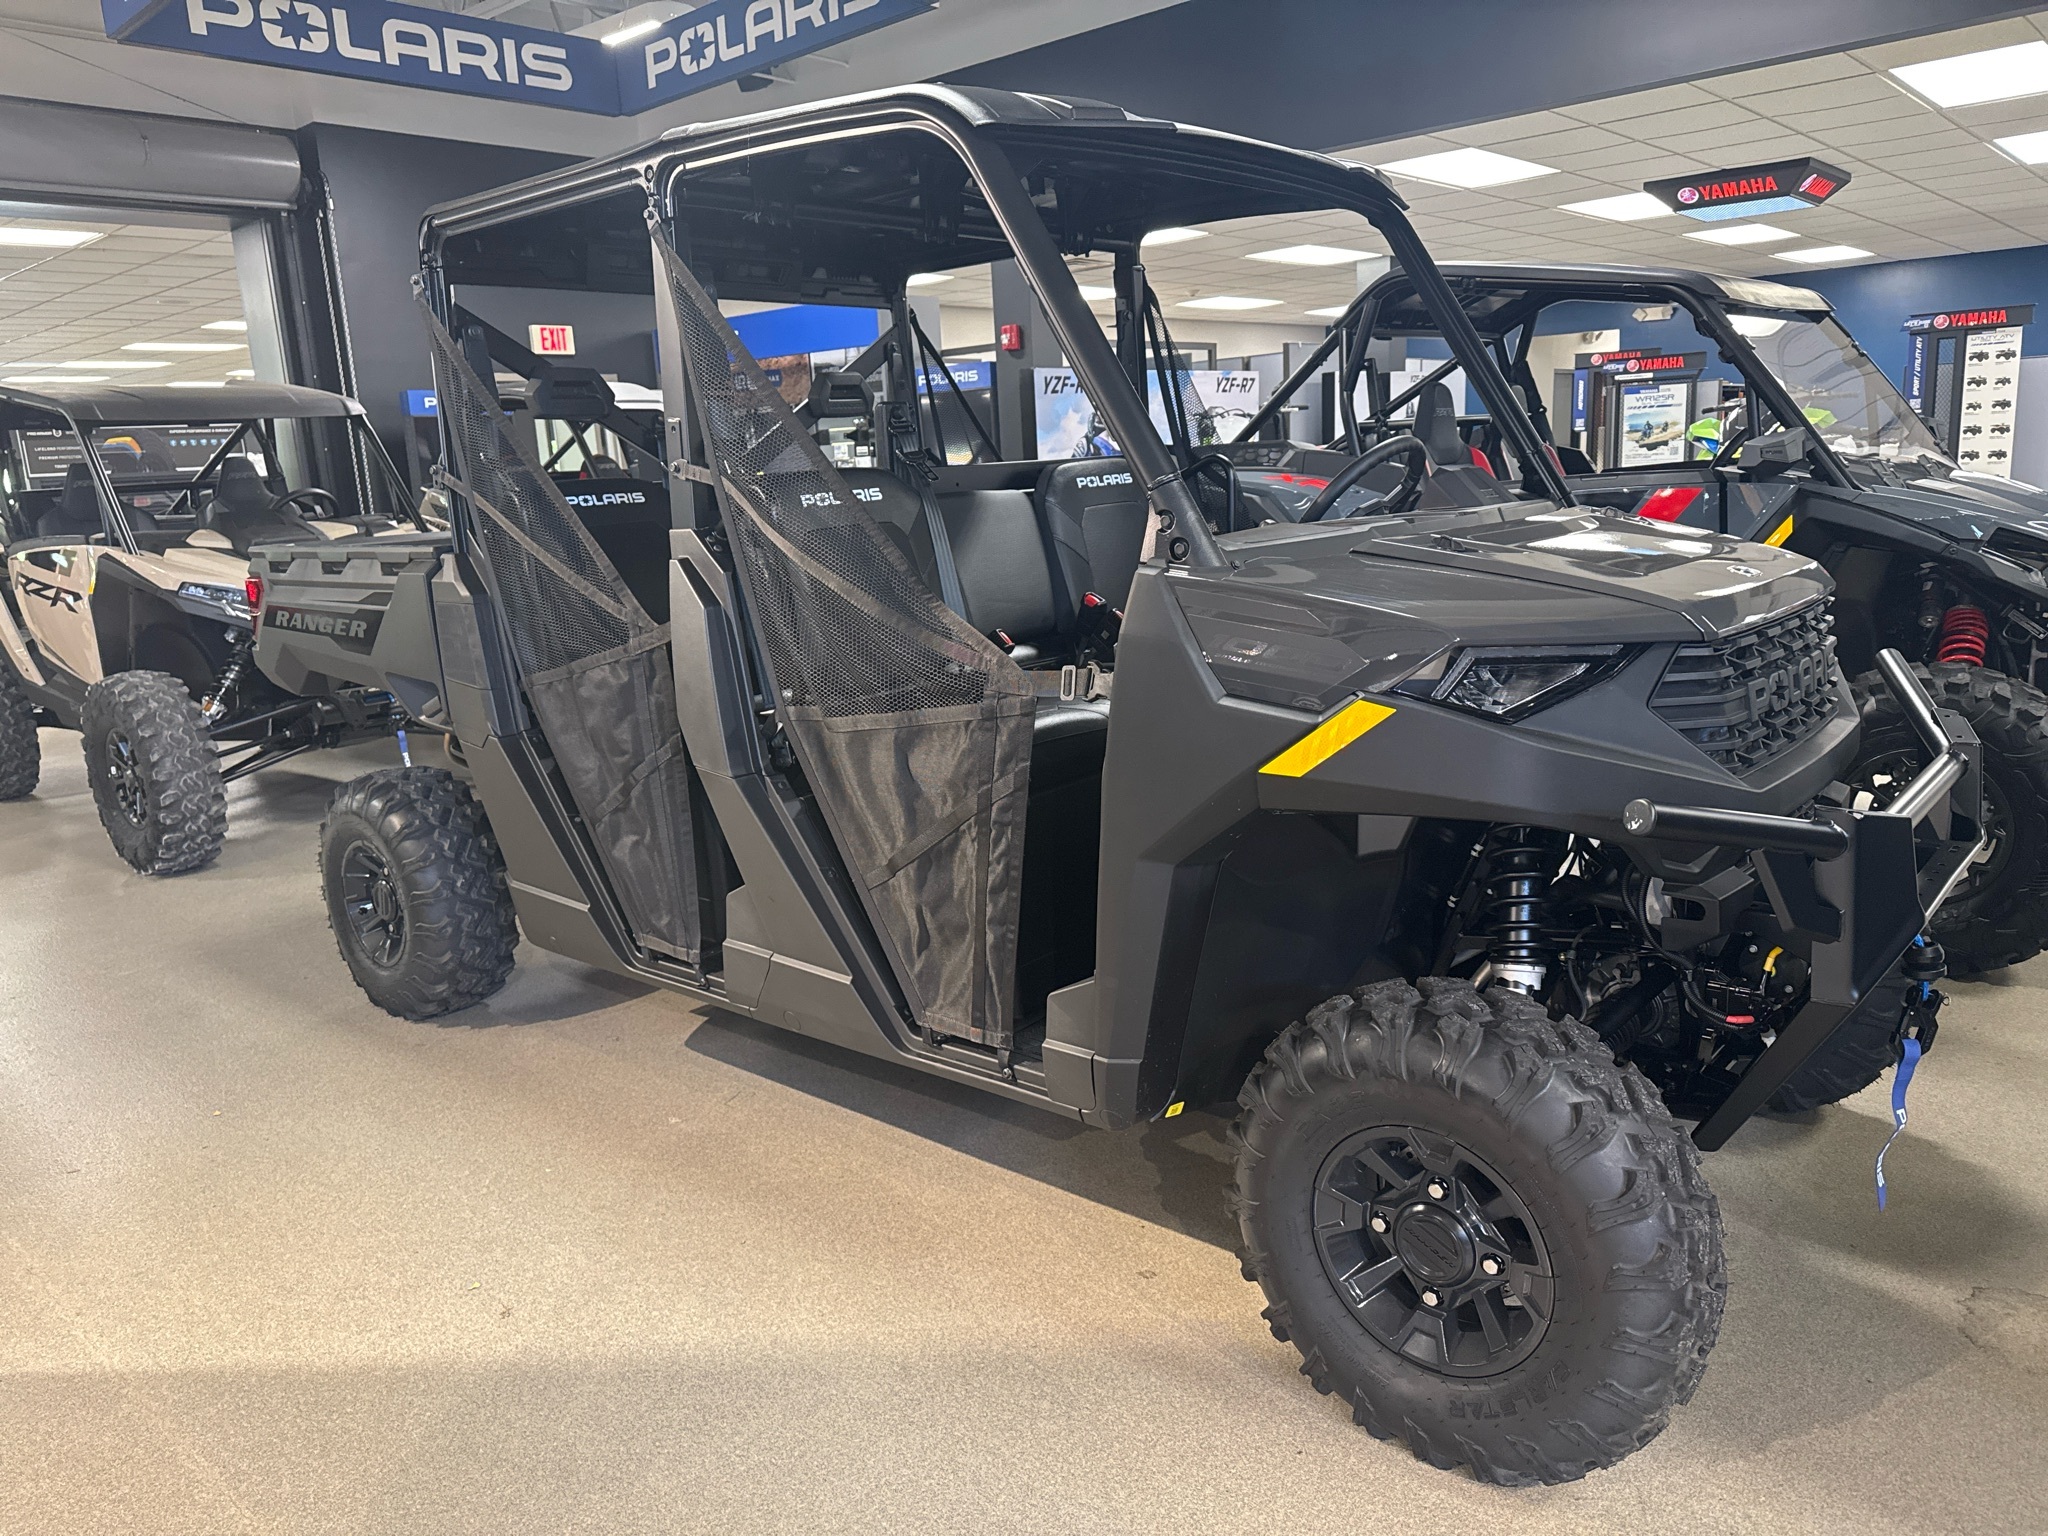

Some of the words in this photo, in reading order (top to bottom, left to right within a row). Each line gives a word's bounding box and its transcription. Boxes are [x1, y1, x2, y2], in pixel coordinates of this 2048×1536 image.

[186, 0, 573, 91] POLARIS
[1699, 176, 1778, 200] YAMAHA
[1951, 310, 2007, 327] YAMAHA
[540, 327, 567, 351] EXIT
[1915, 336, 1923, 349] ATV
[1640, 356, 1684, 371] YAMAHA
[1913, 348, 1922, 371] UTILITY
[1216, 377, 1255, 394] YZF-R7
[1912, 376, 1920, 396] SPORT
[1076, 472, 1133, 489] POLARIS
[565, 492, 646, 507] POLARIS
[15, 570, 83, 614] RZR
[275, 610, 368, 638] RANGER
